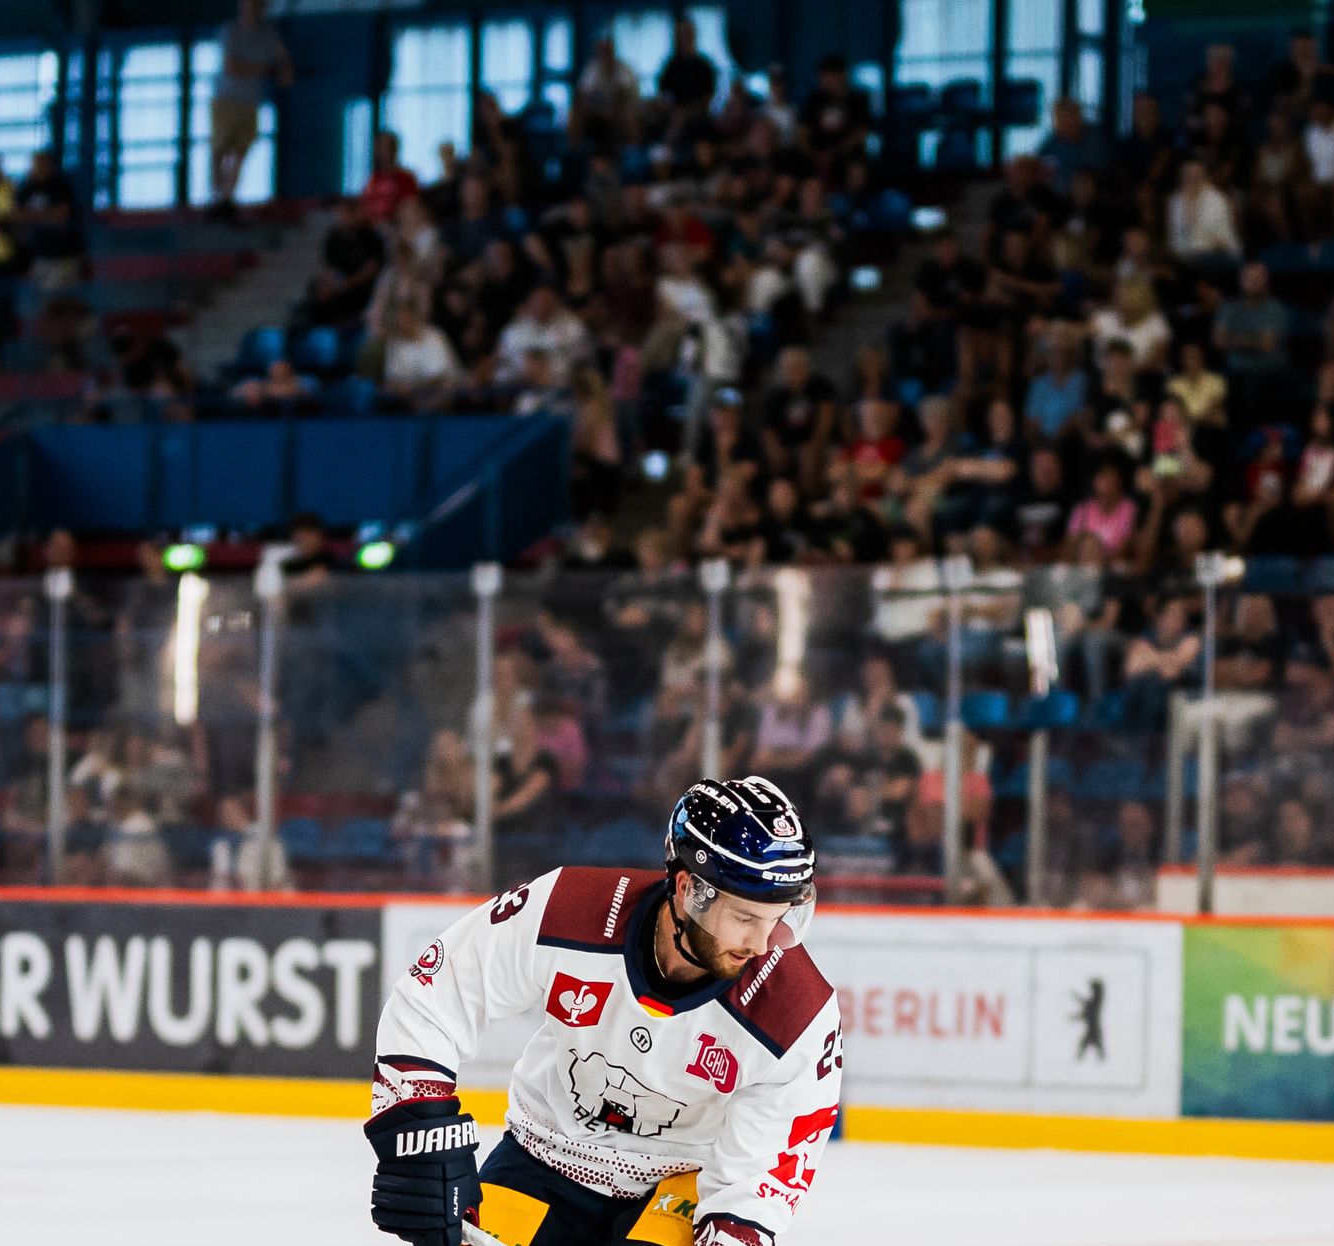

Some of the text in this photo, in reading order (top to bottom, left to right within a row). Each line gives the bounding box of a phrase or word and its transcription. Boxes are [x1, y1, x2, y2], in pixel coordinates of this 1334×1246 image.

[603, 876, 630, 939] WARRIOR
[69, 932, 374, 1050] WURST
[740, 945, 784, 1007] WARRIOR
[839, 986, 1006, 1040] BERLIN
[705, 1050, 727, 1077] CHL
